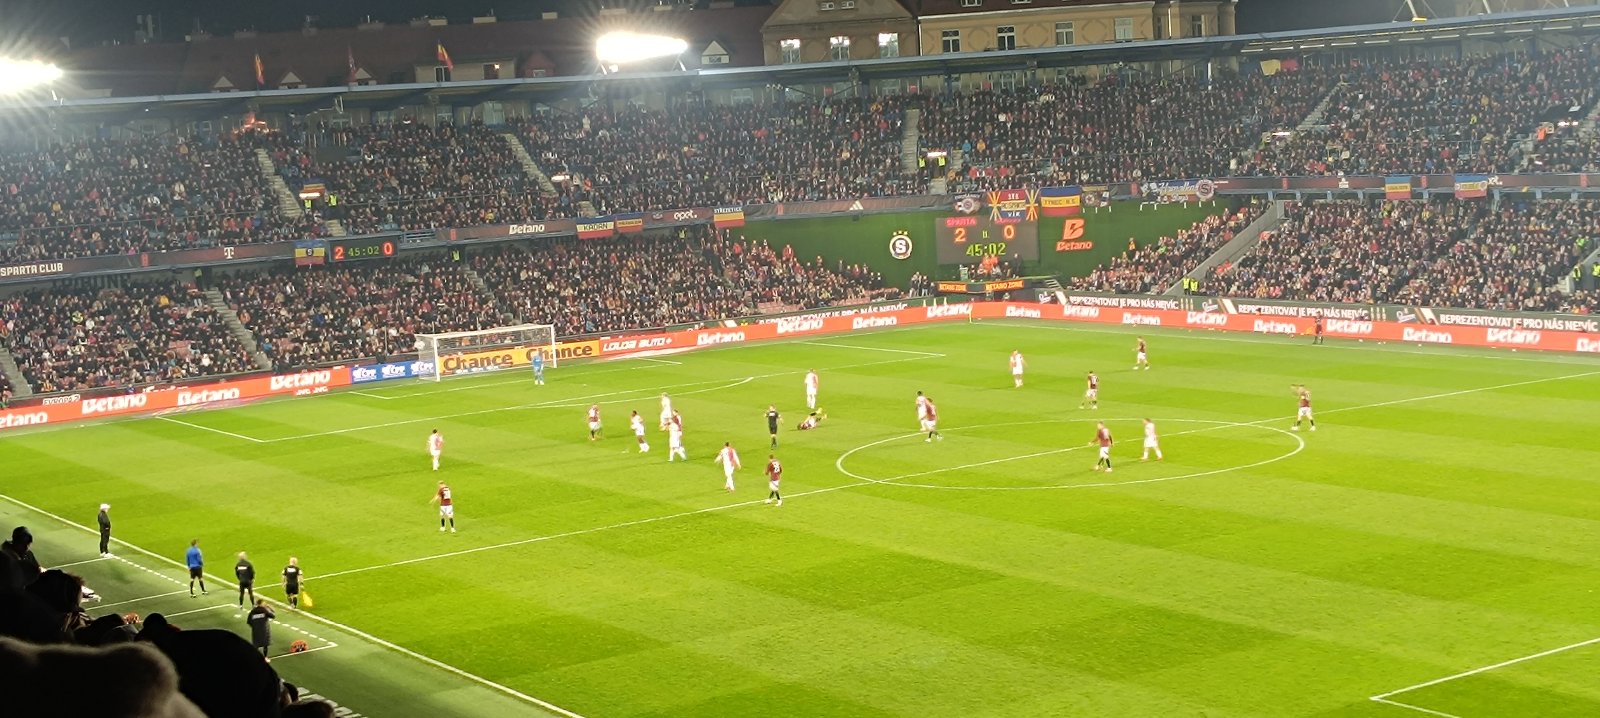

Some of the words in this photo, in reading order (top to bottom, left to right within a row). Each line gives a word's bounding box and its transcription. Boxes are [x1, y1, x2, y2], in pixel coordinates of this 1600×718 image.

[509, 224, 545, 235] Betano
[954, 228, 966, 242] 2
[1003, 225, 1015, 239] 0
[335, 247, 344, 260] 2
[348, 246, 380, 256] 45:02
[384, 243, 392, 255] 0
[966, 242, 1006, 257] 45:02
[1056, 240, 1093, 251] Betano
[1, 265, 37, 276] SPARTA
[40, 263, 63, 272] CLUB
[1119, 298, 1126, 308] JE
[1127, 298, 1140, 307] PRO
[1141, 297, 1155, 308] NÁS
[927, 303, 971, 318] Betano
[1006, 306, 1040, 318] Betano
[1064, 305, 1099, 318] Betano
[1187, 311, 1227, 324] Betano
[1238, 305, 1298, 316] REPREZENTOVAT
[1299, 307, 1306, 317] JE
[1323, 306, 1339, 318] NÁS
[777, 318, 823, 334] Betano
[853, 316, 896, 329] Betano
[1122, 313, 1160, 326] Betano
[1254, 320, 1296, 333] Betano
[1326, 319, 1372, 334] Betano
[1440, 314, 1511, 327] REPREZENTOVAT
[1523, 318, 1543, 328] PRO
[1544, 318, 1564, 329] NÁS
[697, 331, 745, 345] Betano
[1403, 327, 1452, 343] Betano
[1487, 328, 1540, 344] Betano
[526, 344, 592, 360] Chance
[1576, 338, 1600, 352] Bet
[444, 352, 513, 372] Chance
[270, 371, 330, 390] Betano
[82, 392, 147, 414] Betano
[177, 387, 240, 406] Betano
[0, 411, 47, 428] etano
